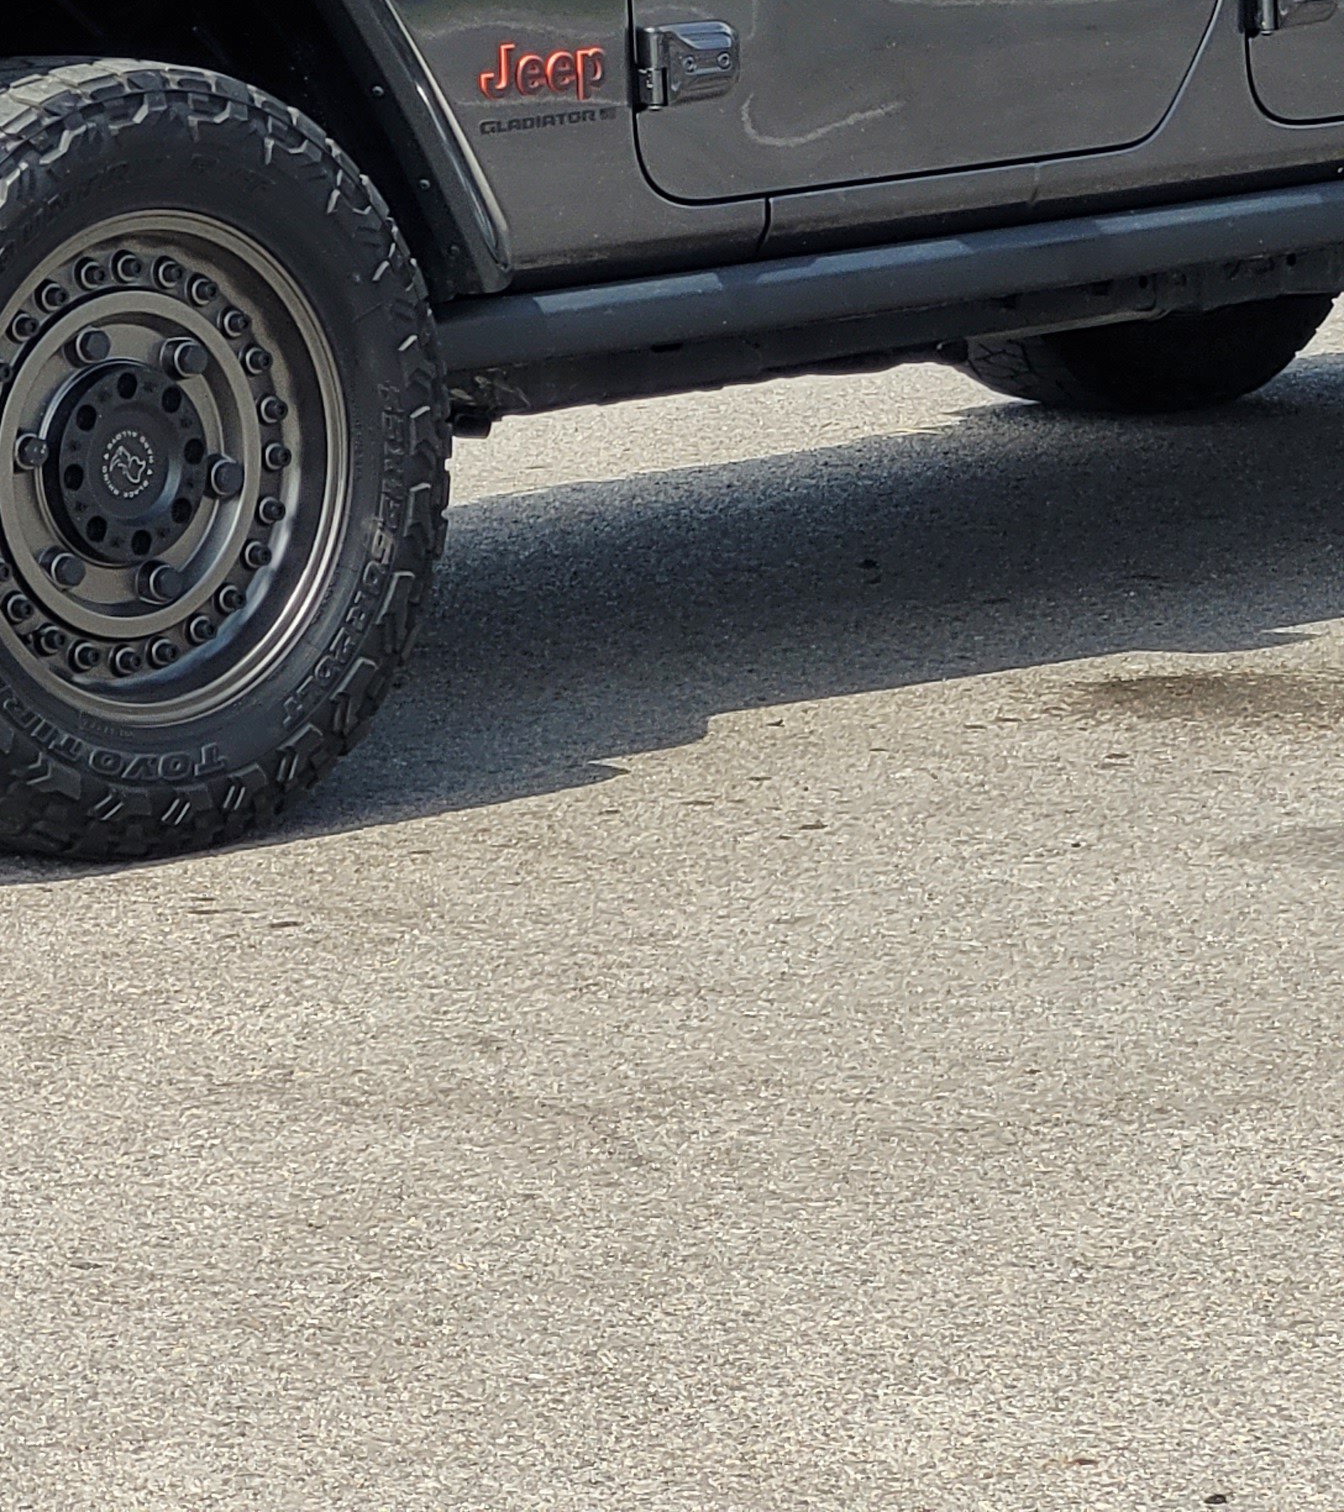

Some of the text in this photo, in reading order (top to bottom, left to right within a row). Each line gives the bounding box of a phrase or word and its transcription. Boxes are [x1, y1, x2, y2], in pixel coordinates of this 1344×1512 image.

[479, 41, 605, 100] Jeep
[479, 107, 596, 135] GLADIATOR
[88, 740, 227, 781] TOYO
